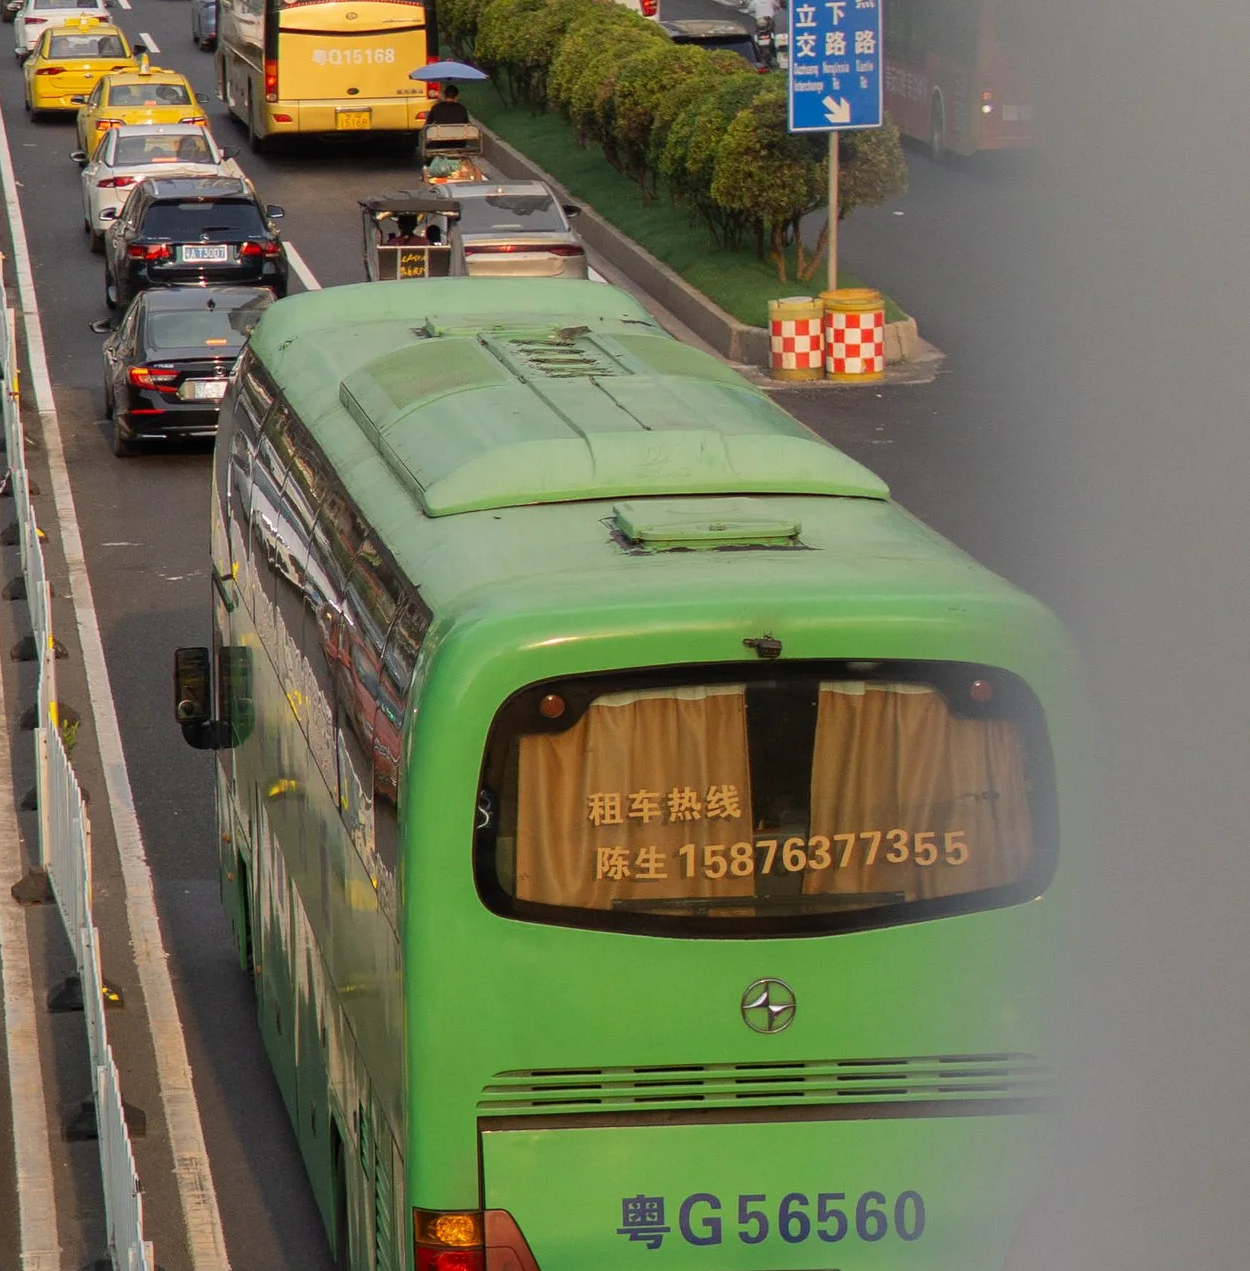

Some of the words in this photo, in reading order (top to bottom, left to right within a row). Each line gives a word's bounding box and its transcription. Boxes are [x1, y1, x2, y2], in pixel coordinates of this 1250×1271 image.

[587, 785, 743, 828] 租车热线
[596, 846, 669, 882] 陈生
[677, 830, 969, 879] 15876377355
[616, 1190, 927, 1250] 粤G56560
